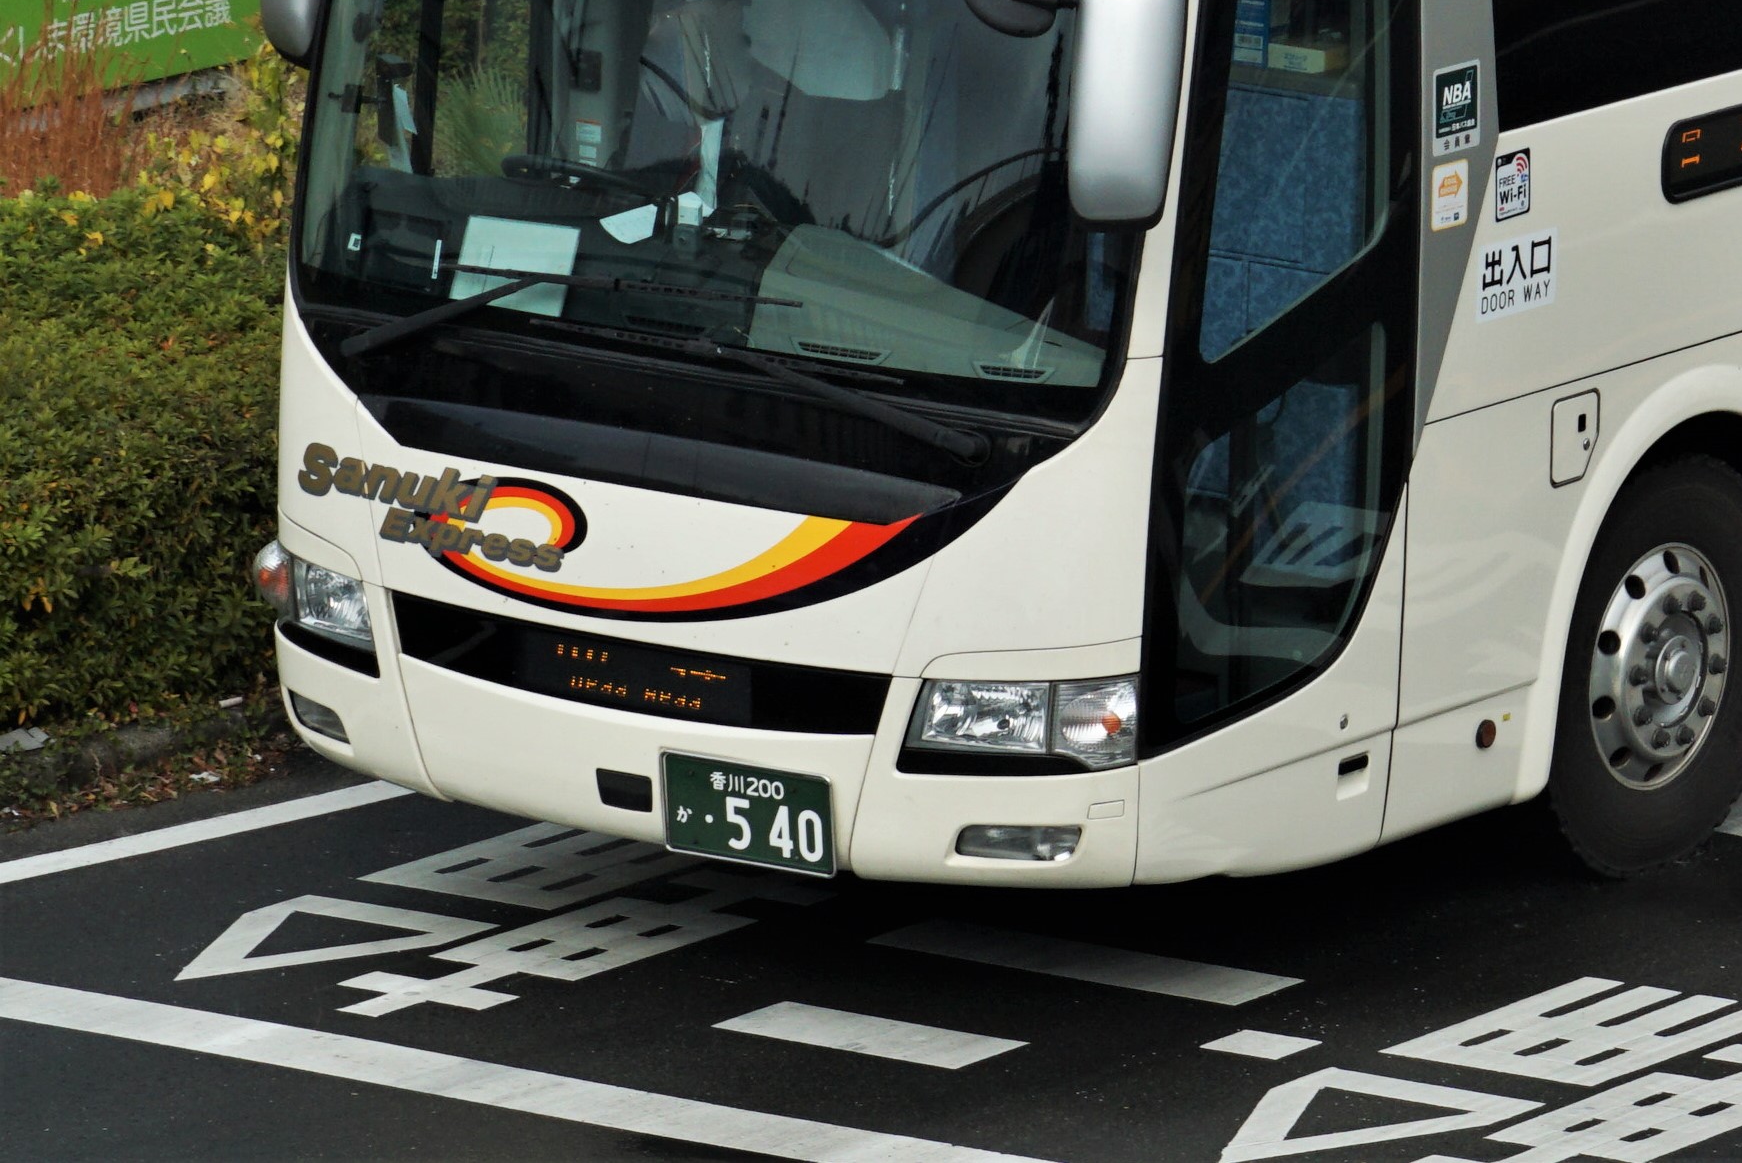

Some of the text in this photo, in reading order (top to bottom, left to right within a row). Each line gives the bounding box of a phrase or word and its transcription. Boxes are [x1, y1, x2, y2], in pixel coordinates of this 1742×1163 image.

[1442, 80, 1472, 106] NBA
[1498, 173, 1516, 189] FREE
[1499, 183, 1527, 205] Wi-Fi
[1481, 235, 1553, 292] 出入口
[1480, 279, 1551, 315] DOOR WAY
[298, 442, 498, 524] Sanuki
[379, 506, 565, 573] Express
[676, 805, 693, 824] か
